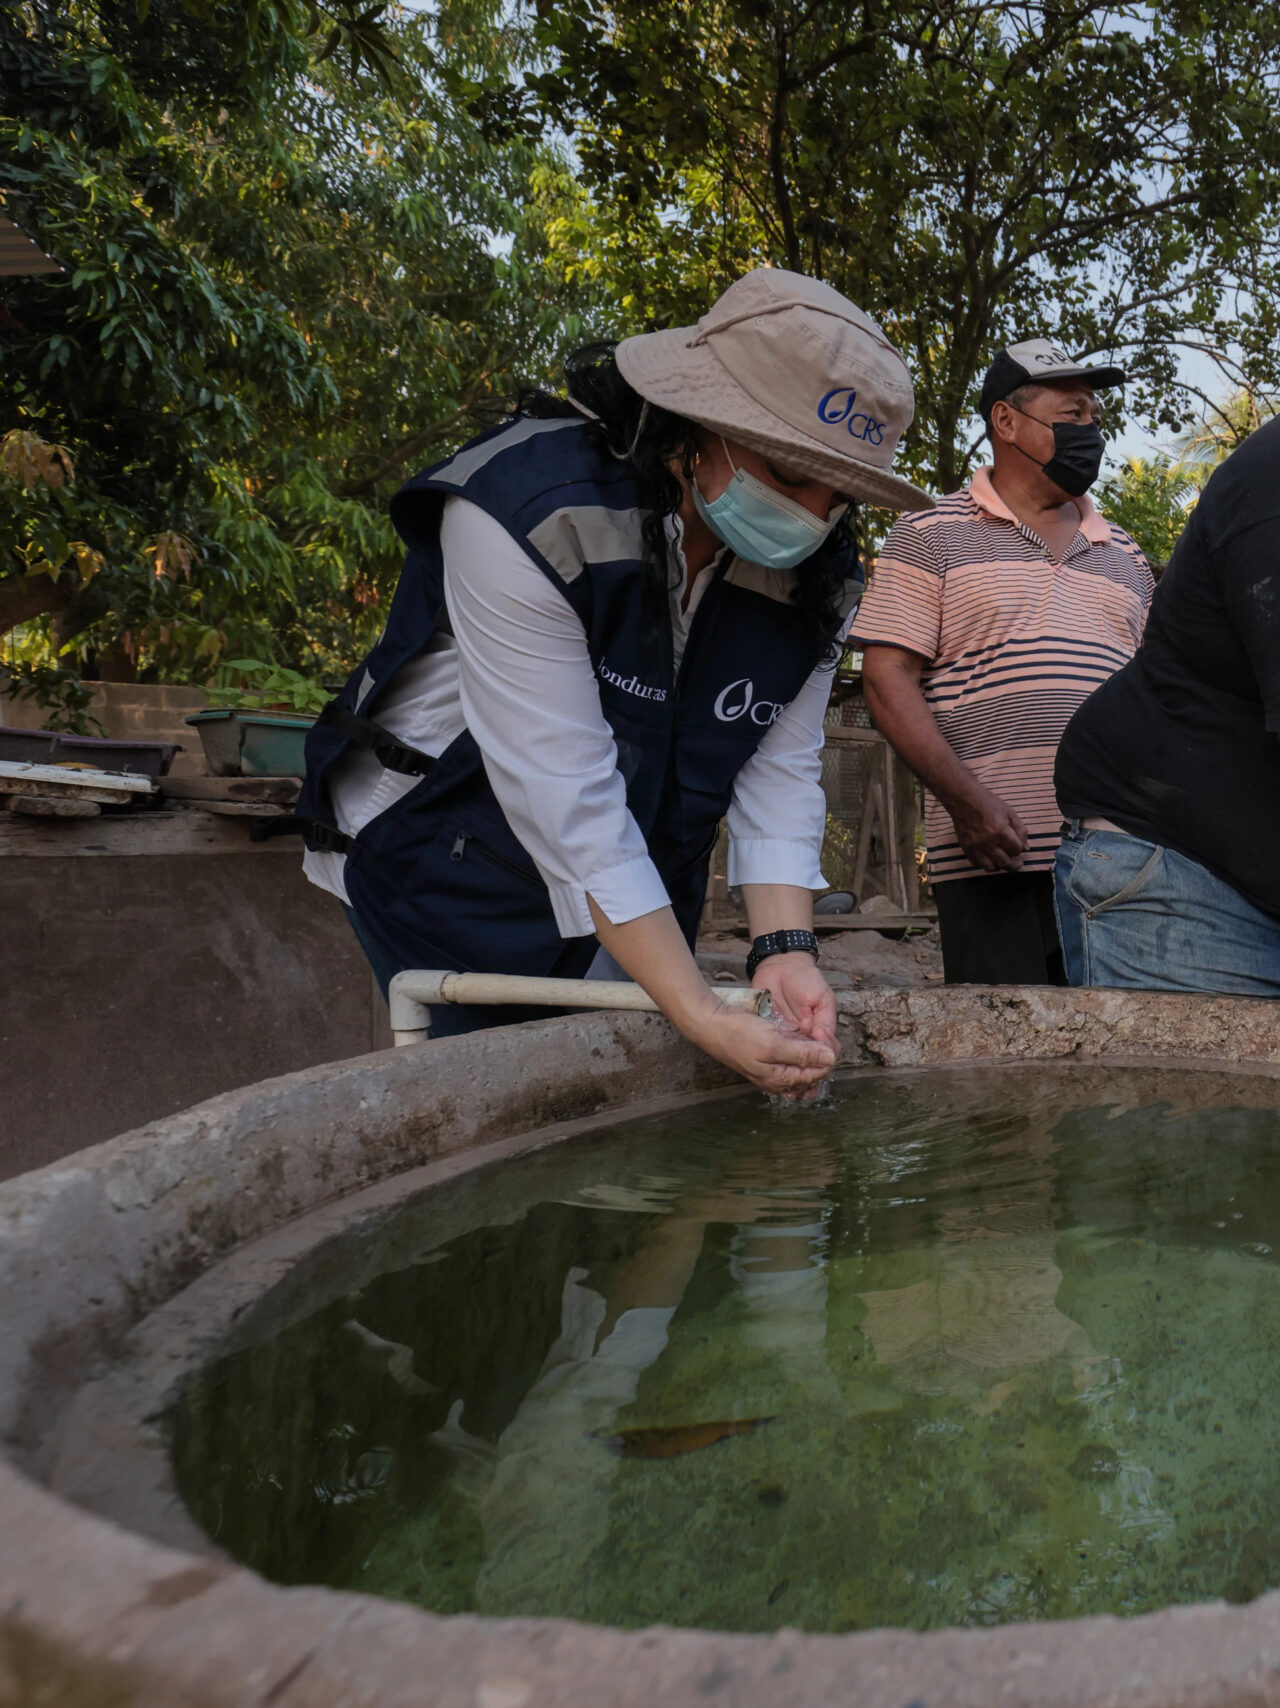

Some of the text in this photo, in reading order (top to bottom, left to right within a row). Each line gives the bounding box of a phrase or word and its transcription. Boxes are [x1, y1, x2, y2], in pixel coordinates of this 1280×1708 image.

[848, 413, 886, 446] CRS
[599, 656, 666, 701] onduras
[751, 701, 791, 725] CR
